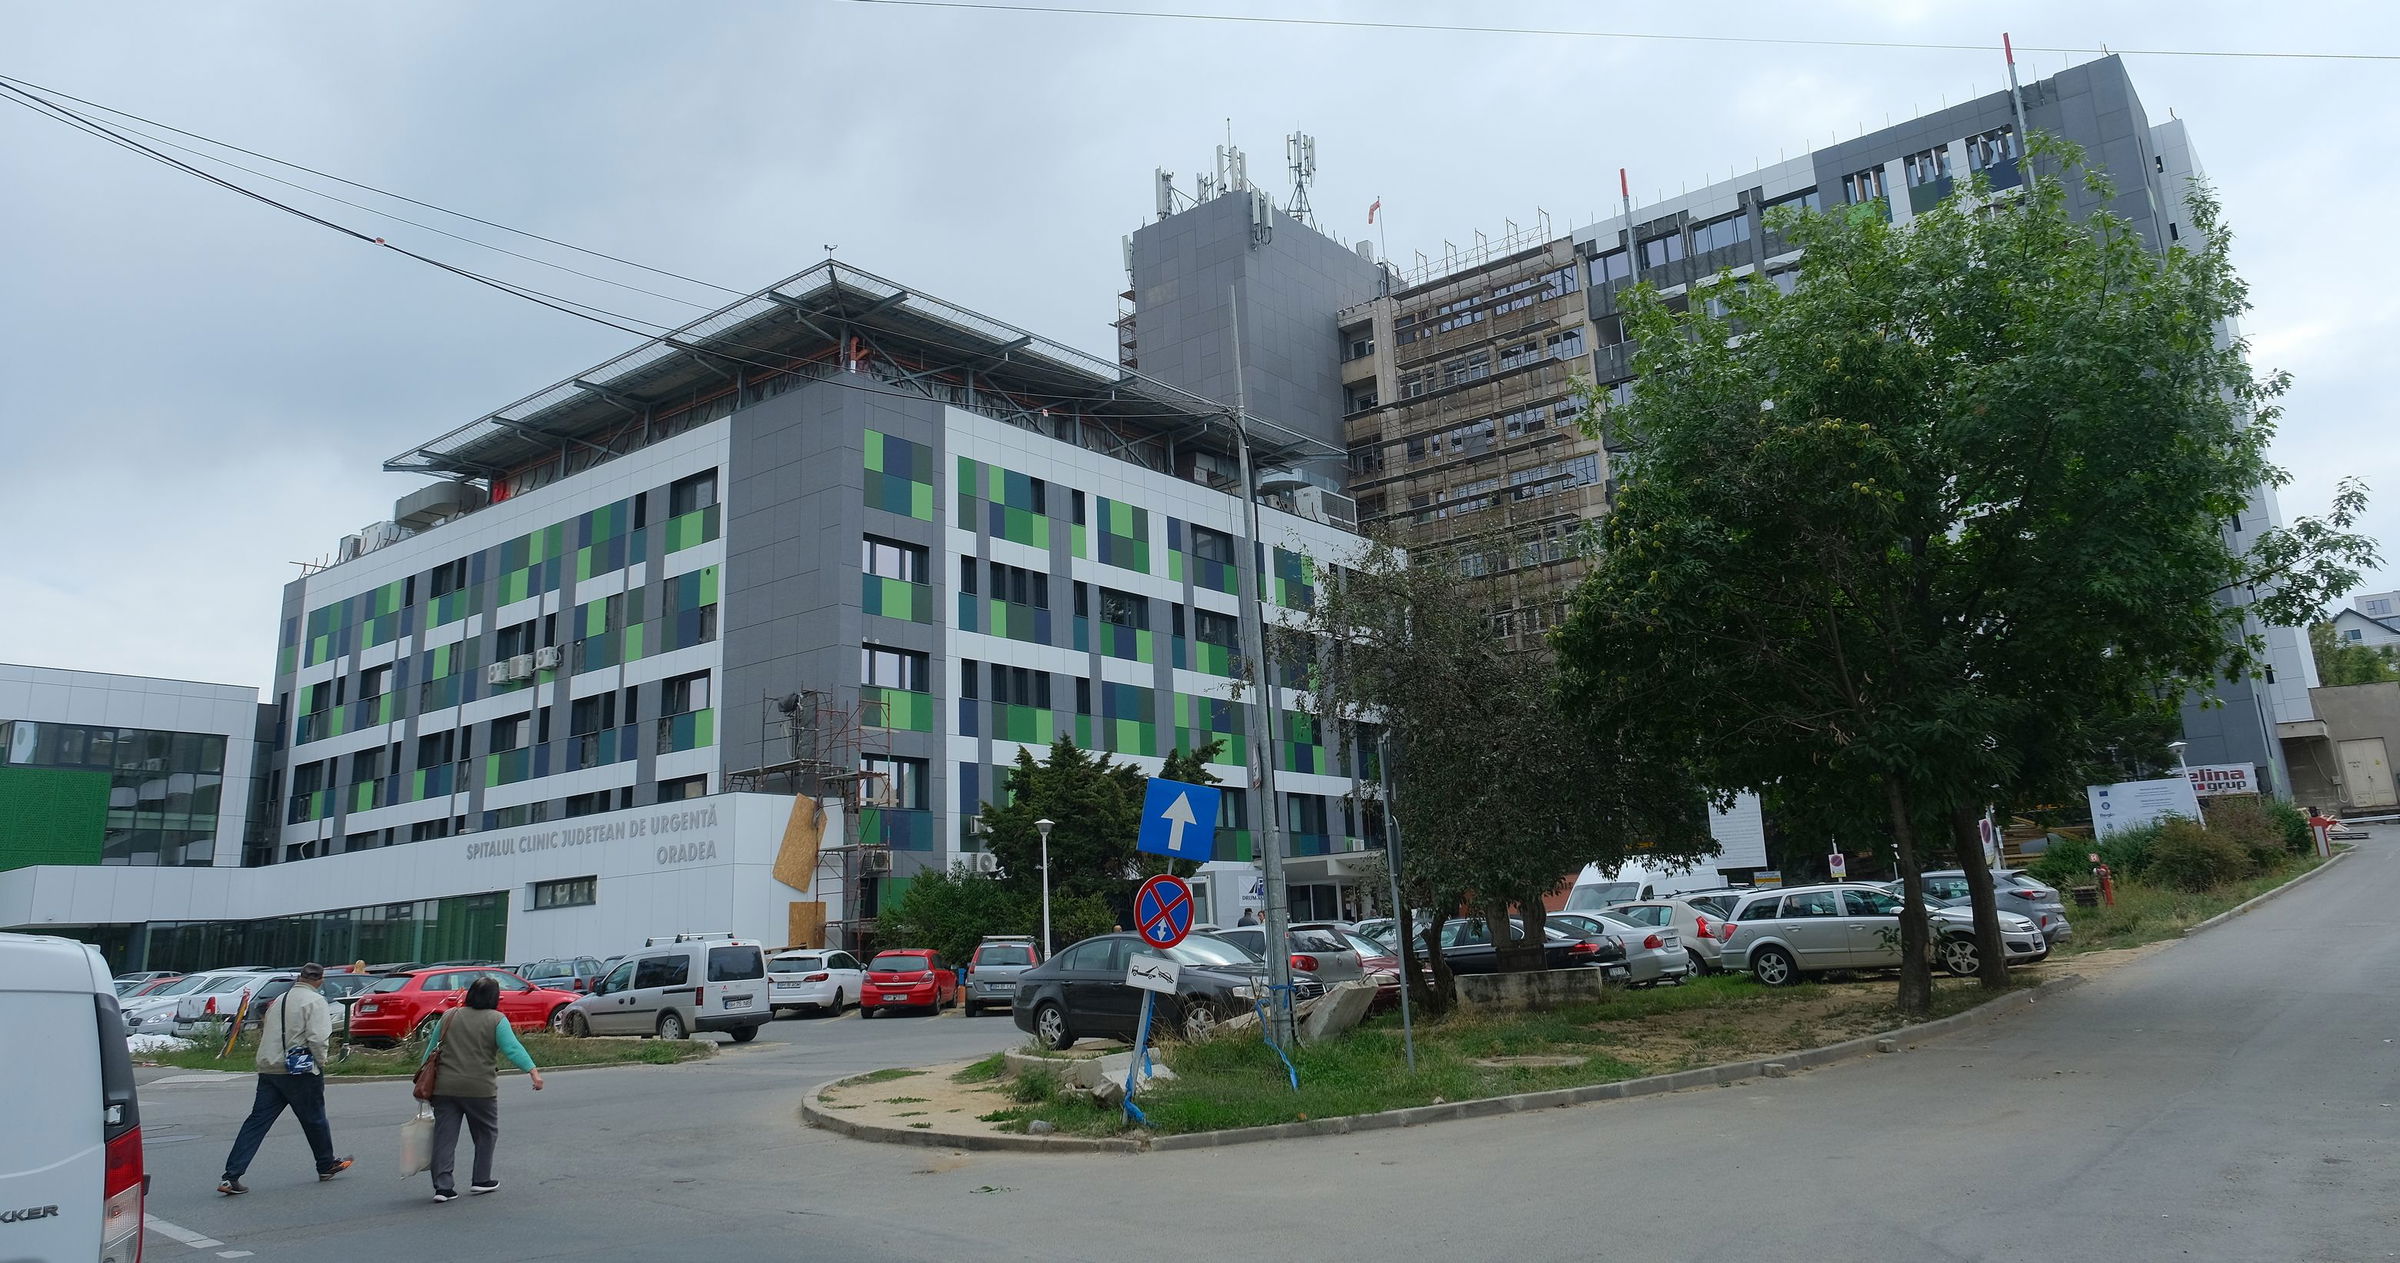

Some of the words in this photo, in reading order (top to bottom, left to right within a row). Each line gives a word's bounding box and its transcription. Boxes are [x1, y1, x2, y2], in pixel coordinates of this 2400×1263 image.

[2177, 768, 2245, 783] elina
[2207, 780, 2247, 792] grup
[466, 838, 515, 861] SPITALUL
[519, 831, 558, 853] CLINIC
[561, 822, 626, 848] JUDETEAN
[629, 818, 646, 838] DE
[650, 803, 718, 835] URGENTĂ
[657, 840, 717, 865] ORADEA
